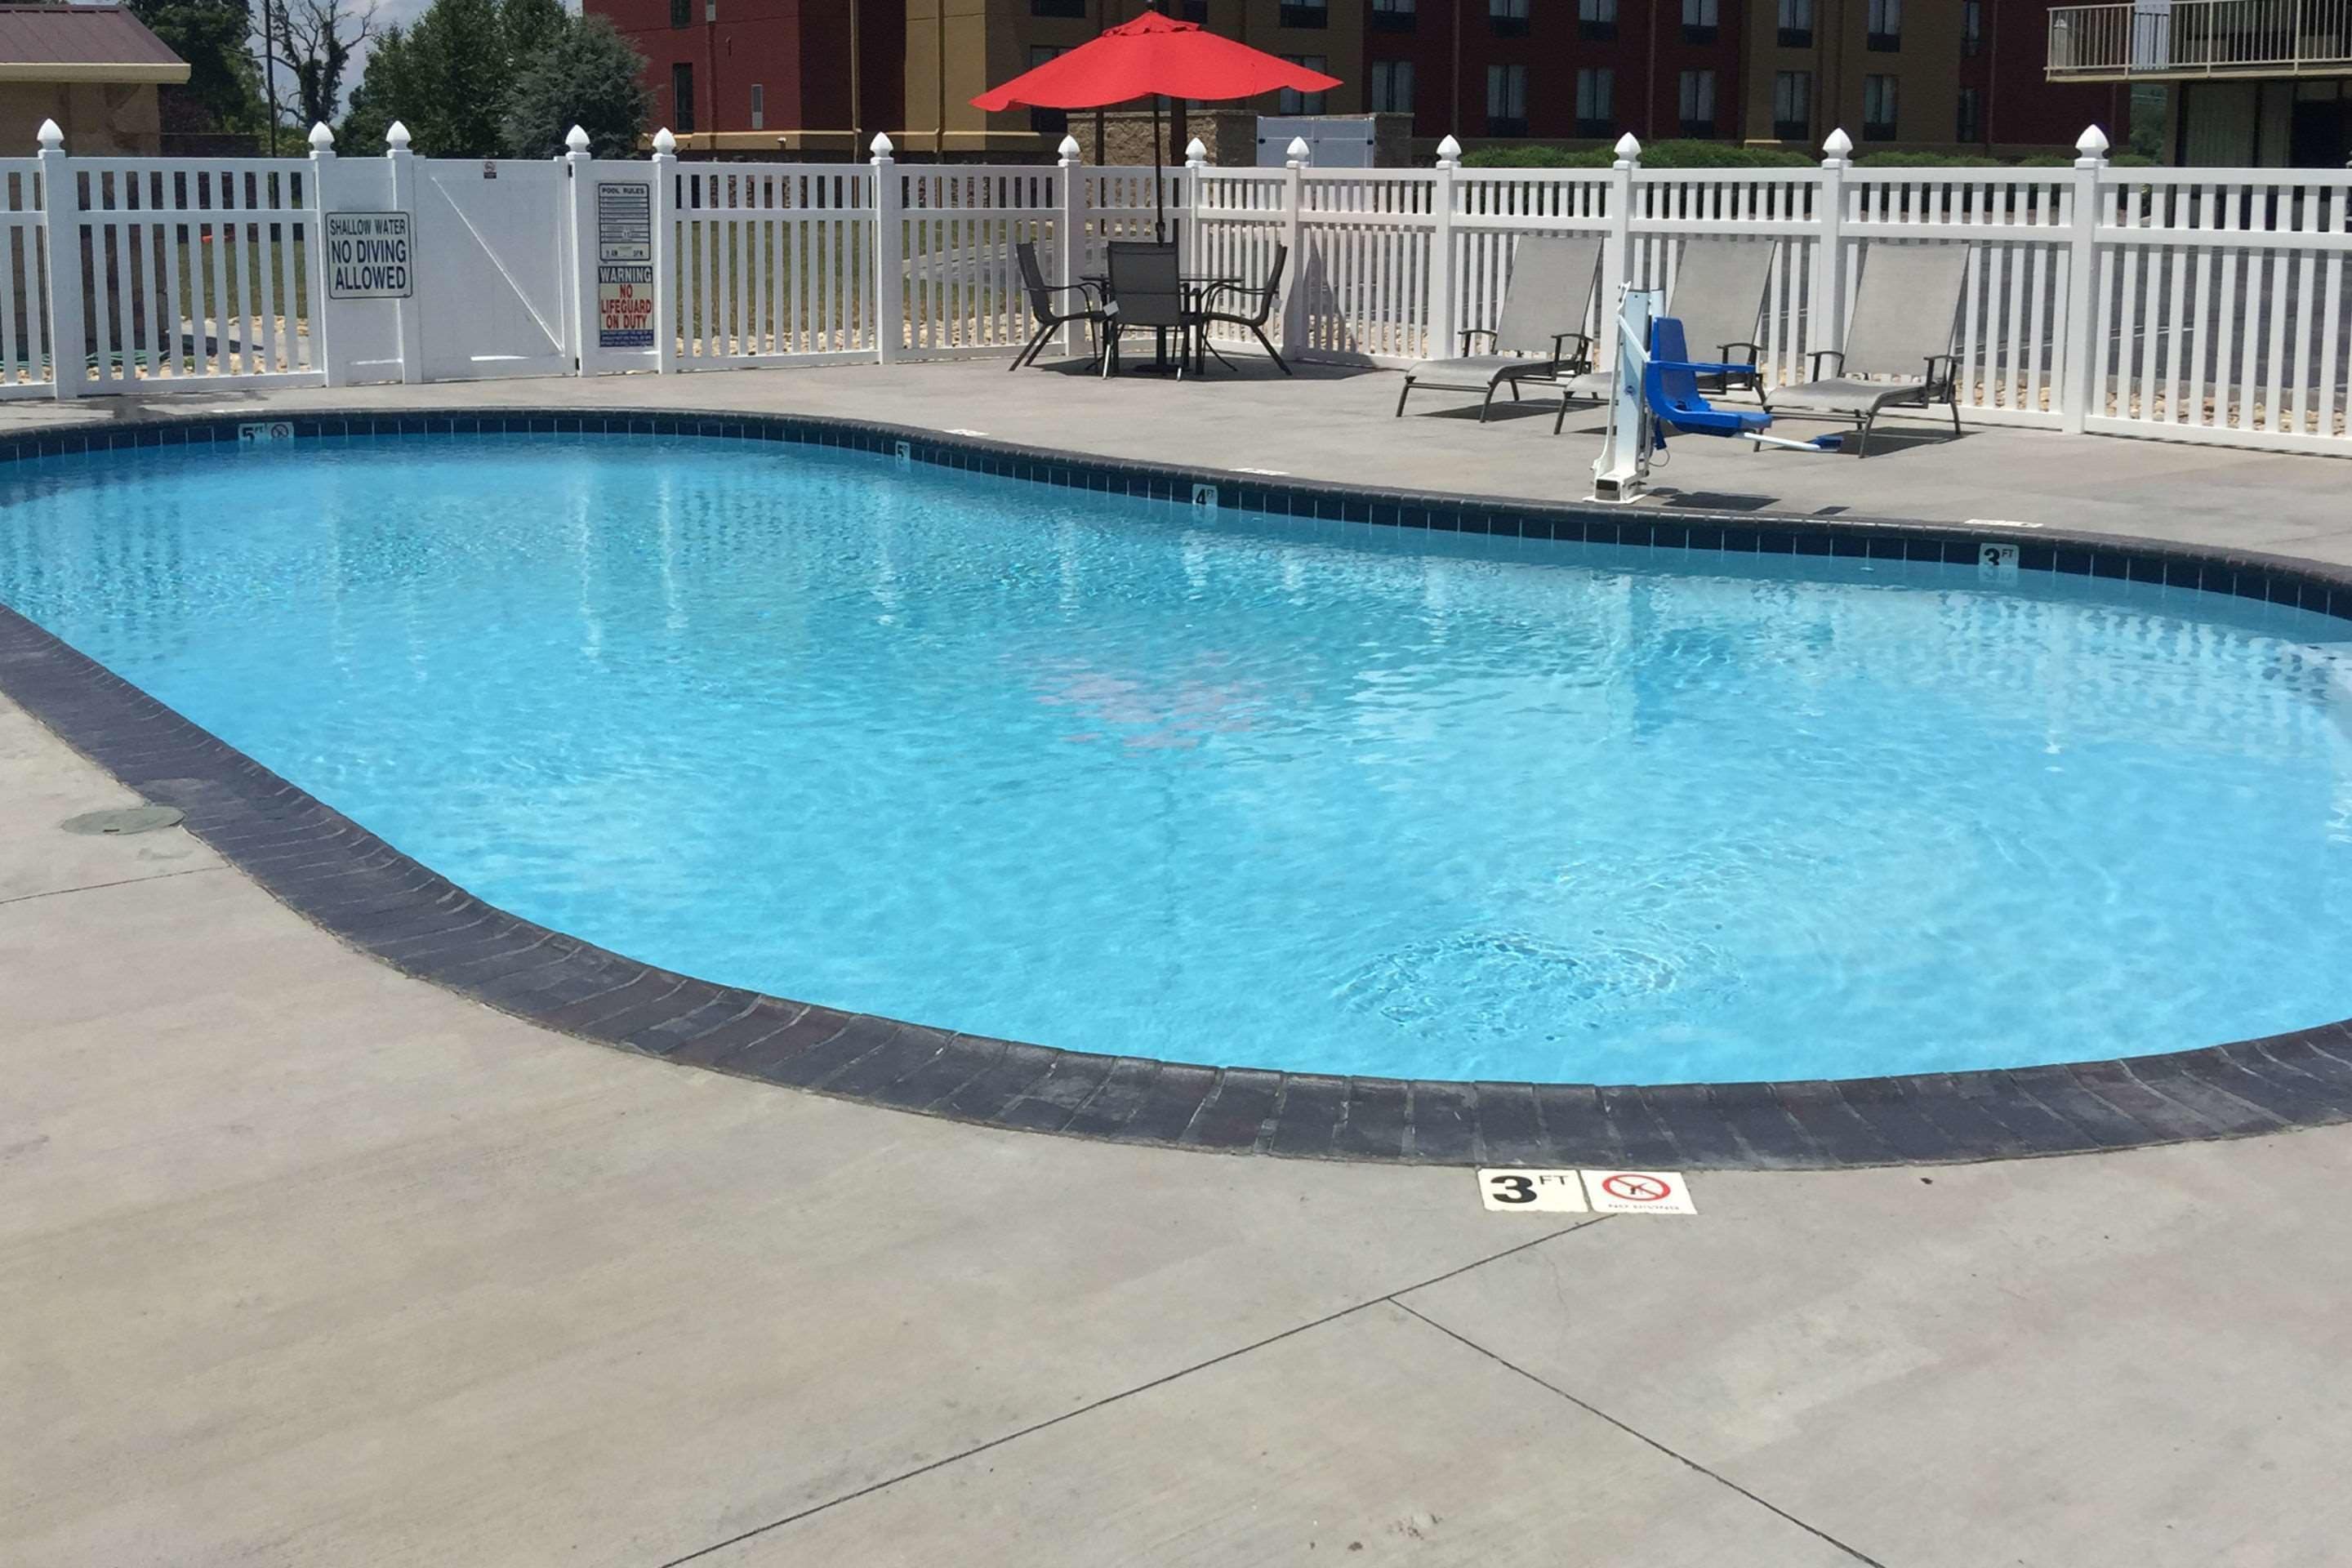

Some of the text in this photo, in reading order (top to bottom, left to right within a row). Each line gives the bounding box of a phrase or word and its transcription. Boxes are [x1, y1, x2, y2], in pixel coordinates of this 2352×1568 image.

[330, 219, 406, 235] SHALLOW WATER
[331, 239, 406, 263] NO DIVING
[335, 266, 406, 290] ALLOWED
[599, 267, 652, 283] WARNING
[619, 283, 633, 299] NO
[601, 299, 652, 314] LIFEGUARD
[606, 314, 647, 329] ON DUTY
[1196, 488, 1206, 505] 4
[1984, 548, 2000, 566] 3
[1490, 1174, 1570, 1204] 3 FT
